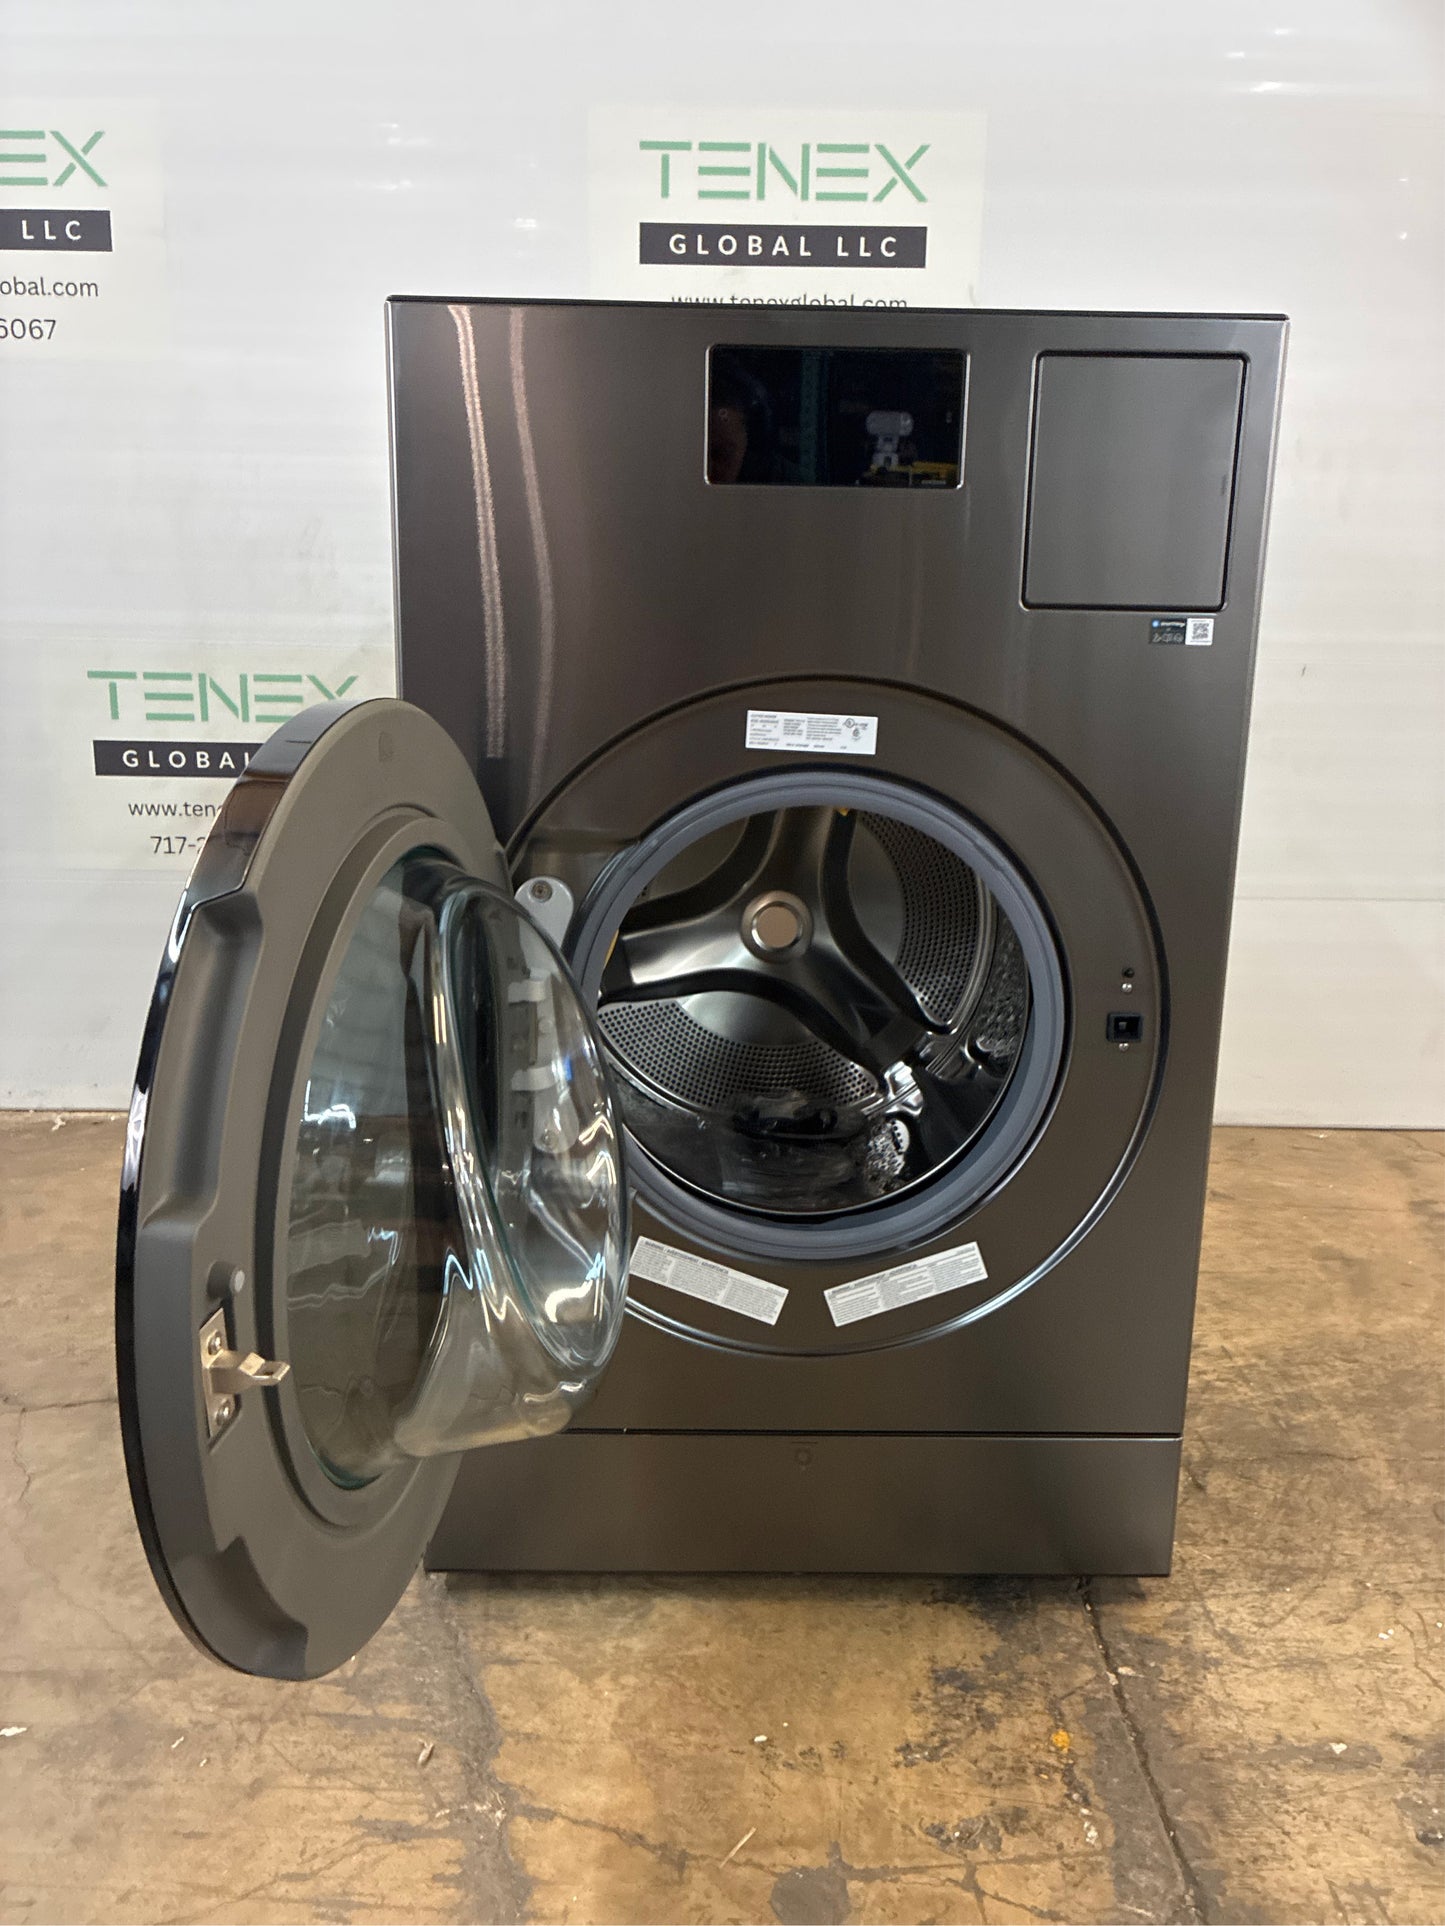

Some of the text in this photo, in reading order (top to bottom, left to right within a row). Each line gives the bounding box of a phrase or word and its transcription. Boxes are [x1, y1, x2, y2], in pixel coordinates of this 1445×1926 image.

[639, 140, 931, 202] TENEX
[21, 220, 82, 241] LLC
[669, 233, 898, 258] GLOBAL LLC
[0, 276, 99, 297] obal.com
[128, 801, 222, 817] www.ten
